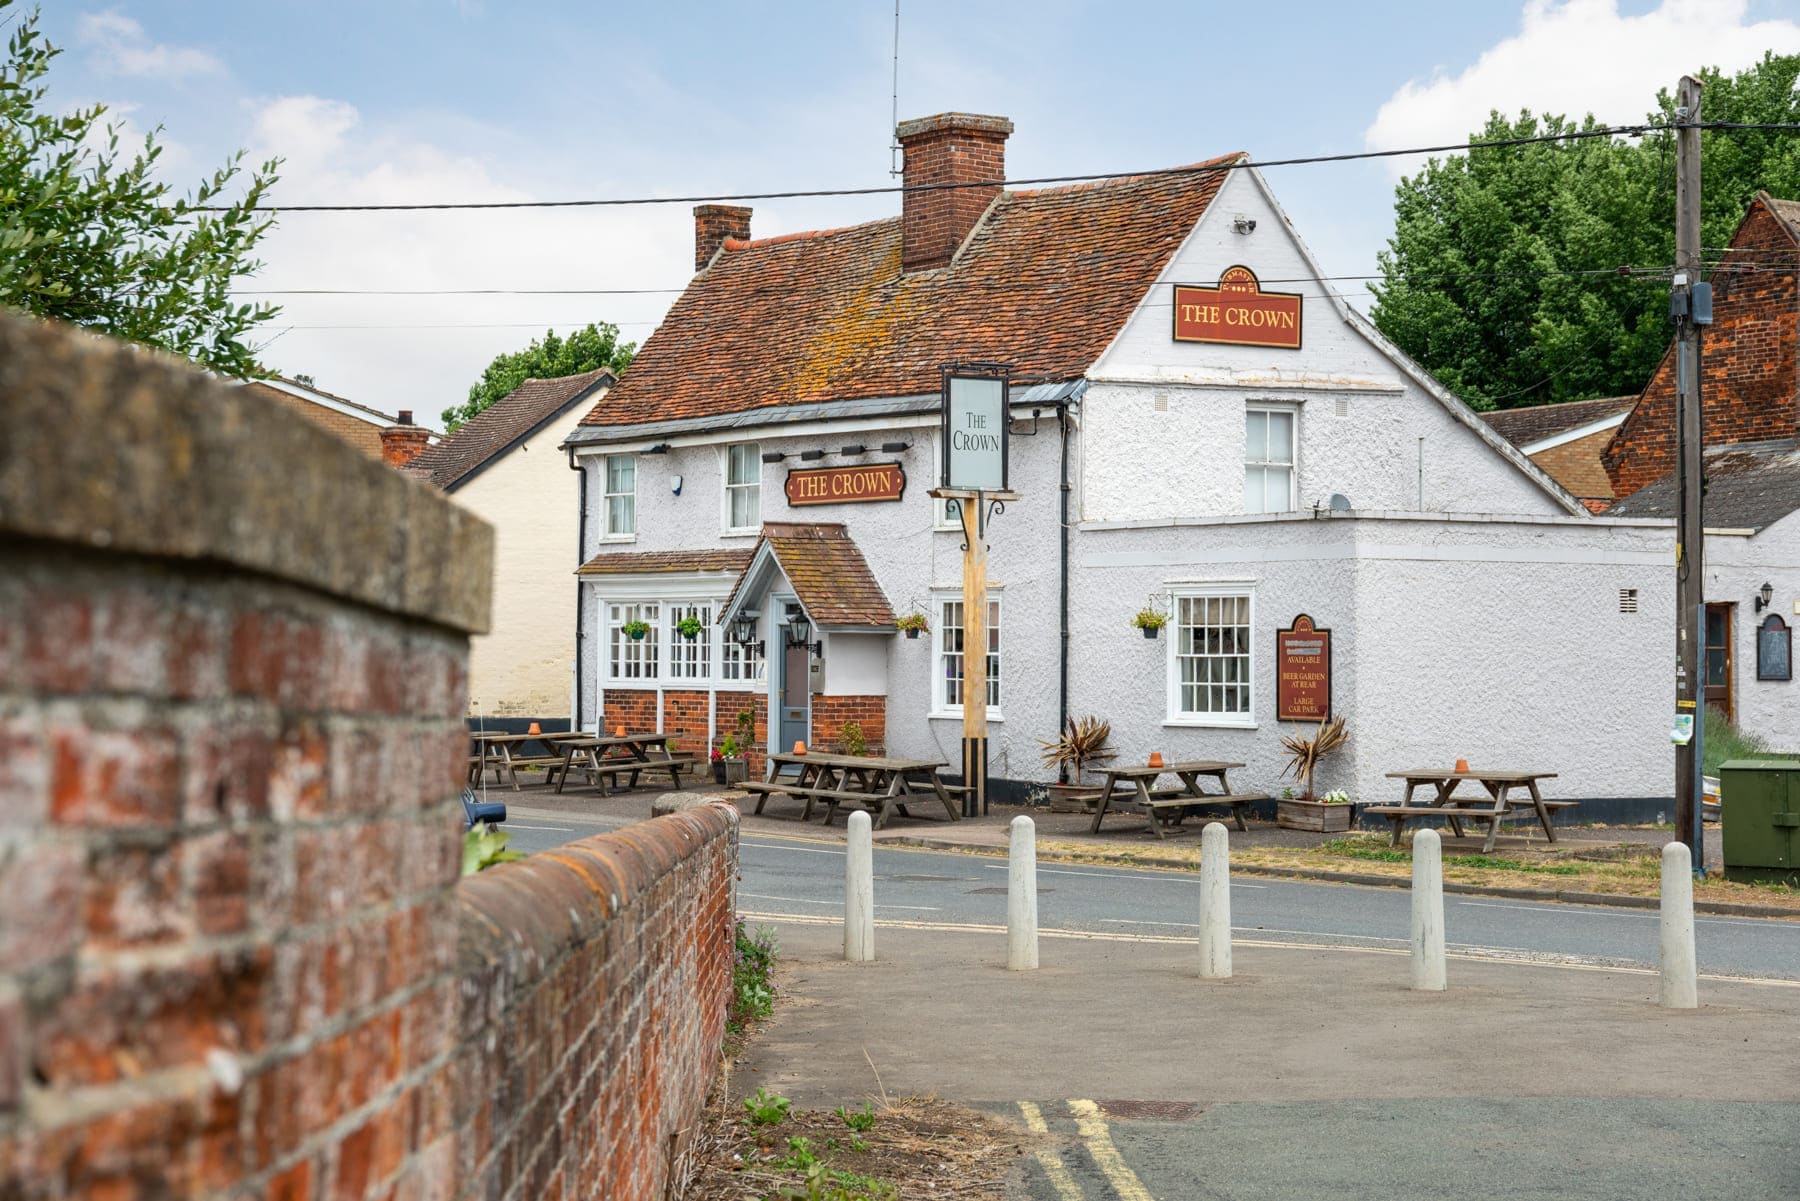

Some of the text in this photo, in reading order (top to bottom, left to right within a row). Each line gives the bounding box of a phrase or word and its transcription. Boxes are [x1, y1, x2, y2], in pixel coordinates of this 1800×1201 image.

[1181, 304, 1295, 329] THE CROWN
[953, 412, 999, 452] THE CROWN
[797, 471, 891, 497] THE CROWN
[1287, 655, 1321, 664] AVAILABLE
[1282, 672, 1326, 681] BEER GARDEN
[1291, 680, 1317, 689] AT REAR
[1293, 697, 1314, 705] LARGE
[1288, 705, 1319, 713] CAR PARK
